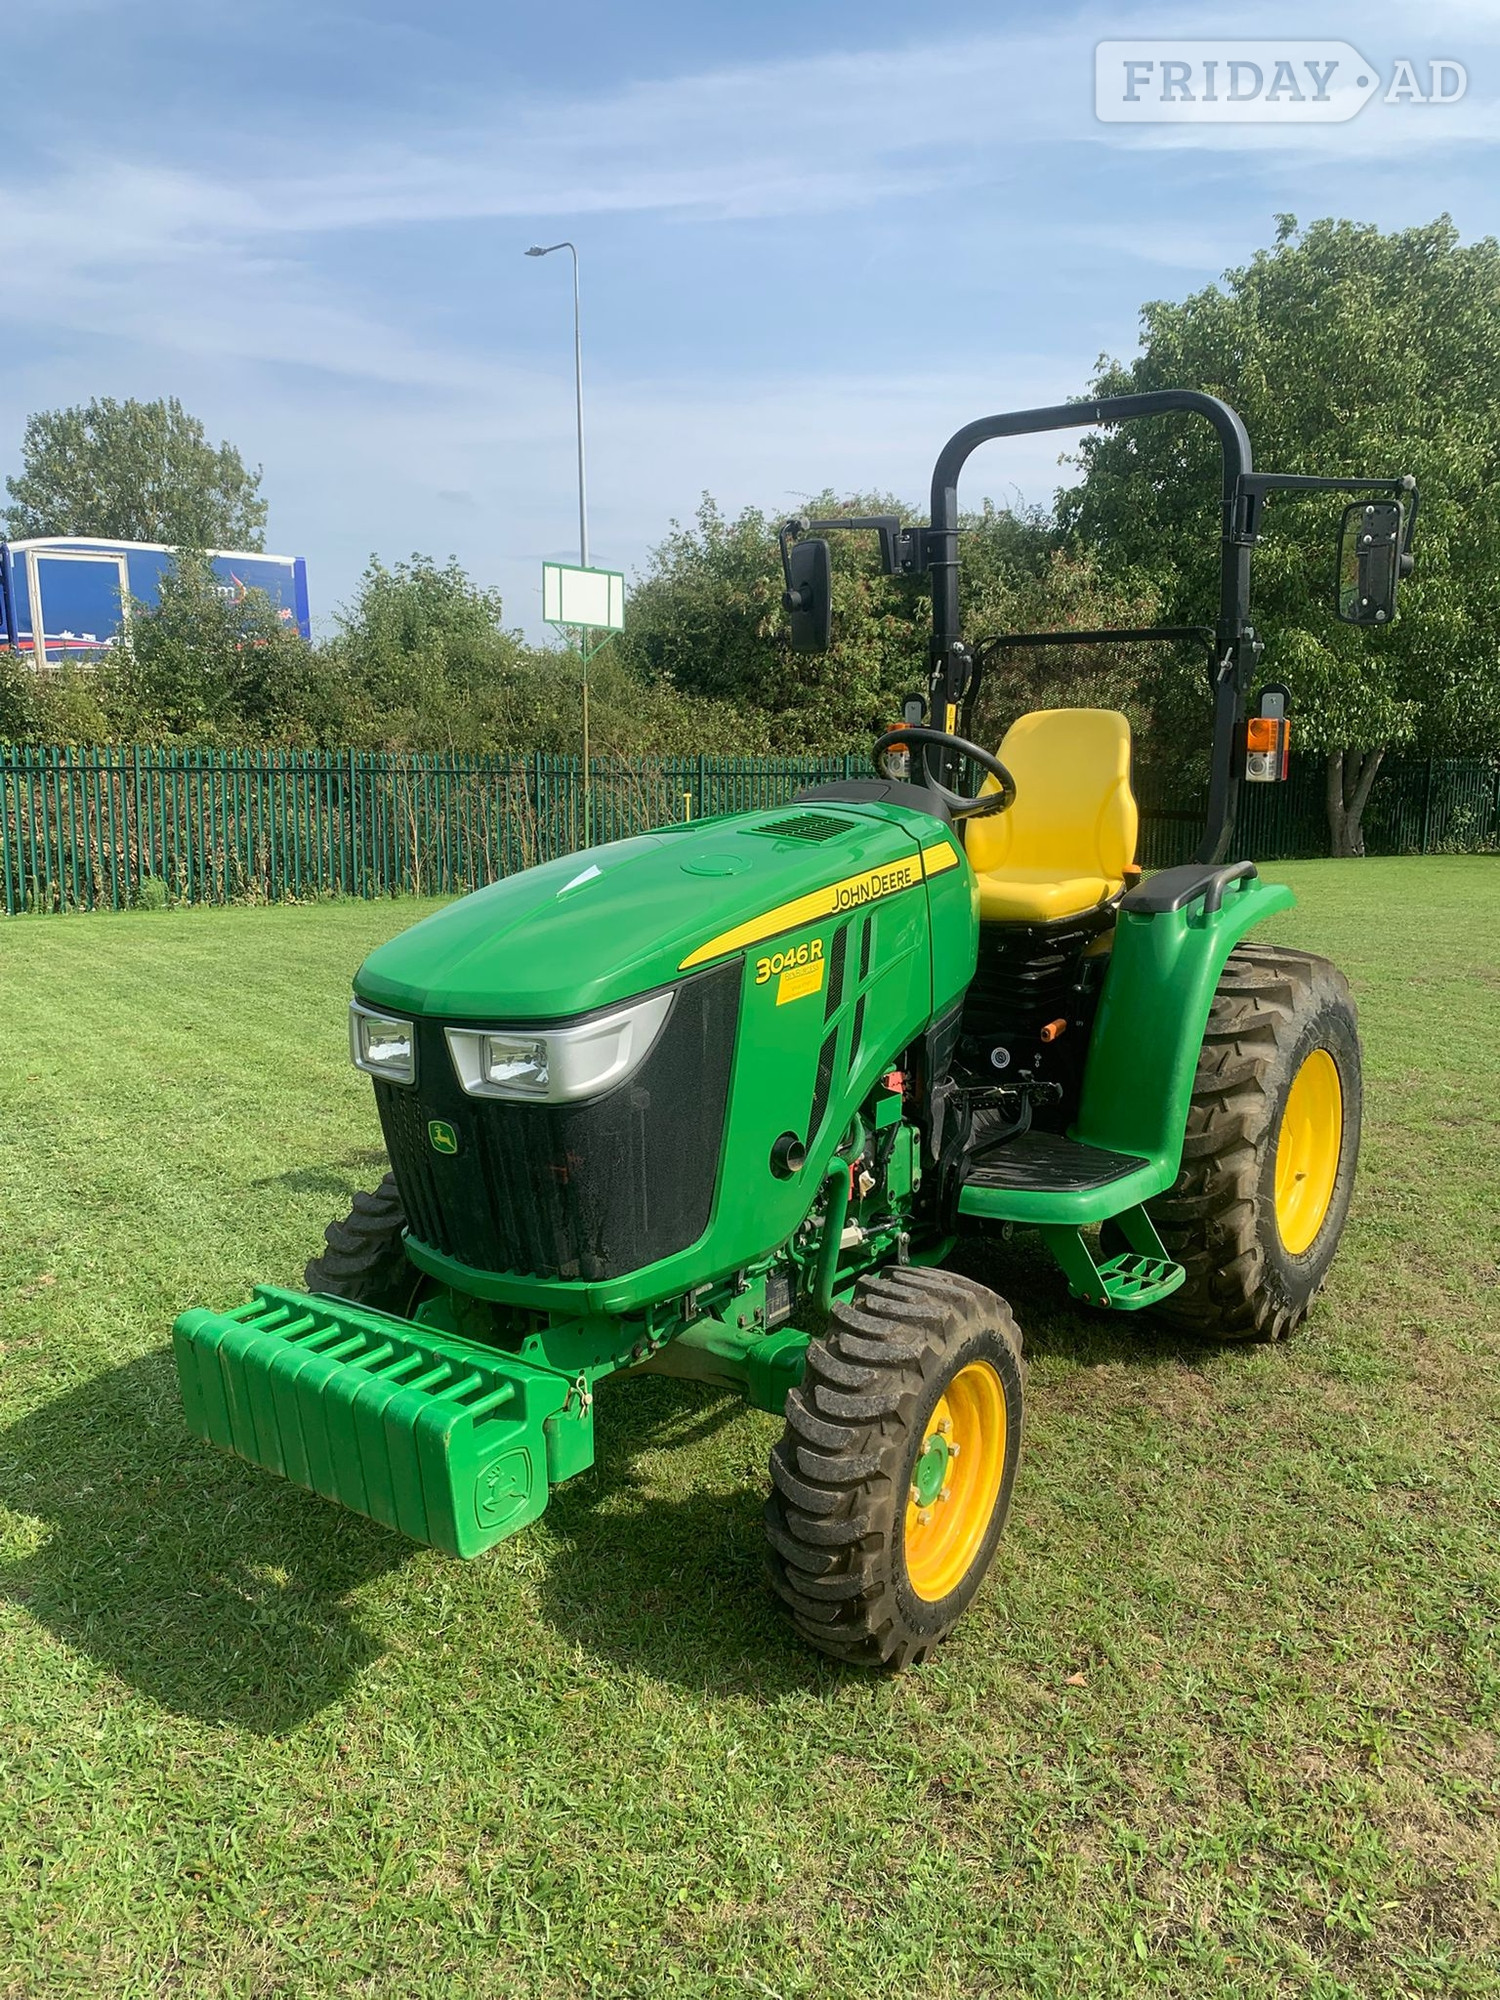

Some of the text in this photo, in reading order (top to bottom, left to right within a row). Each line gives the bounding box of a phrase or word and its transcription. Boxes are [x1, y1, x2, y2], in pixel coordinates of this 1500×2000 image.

[832, 868, 912, 911] JOHN DEERE
[756, 938, 823, 984] 3046R
